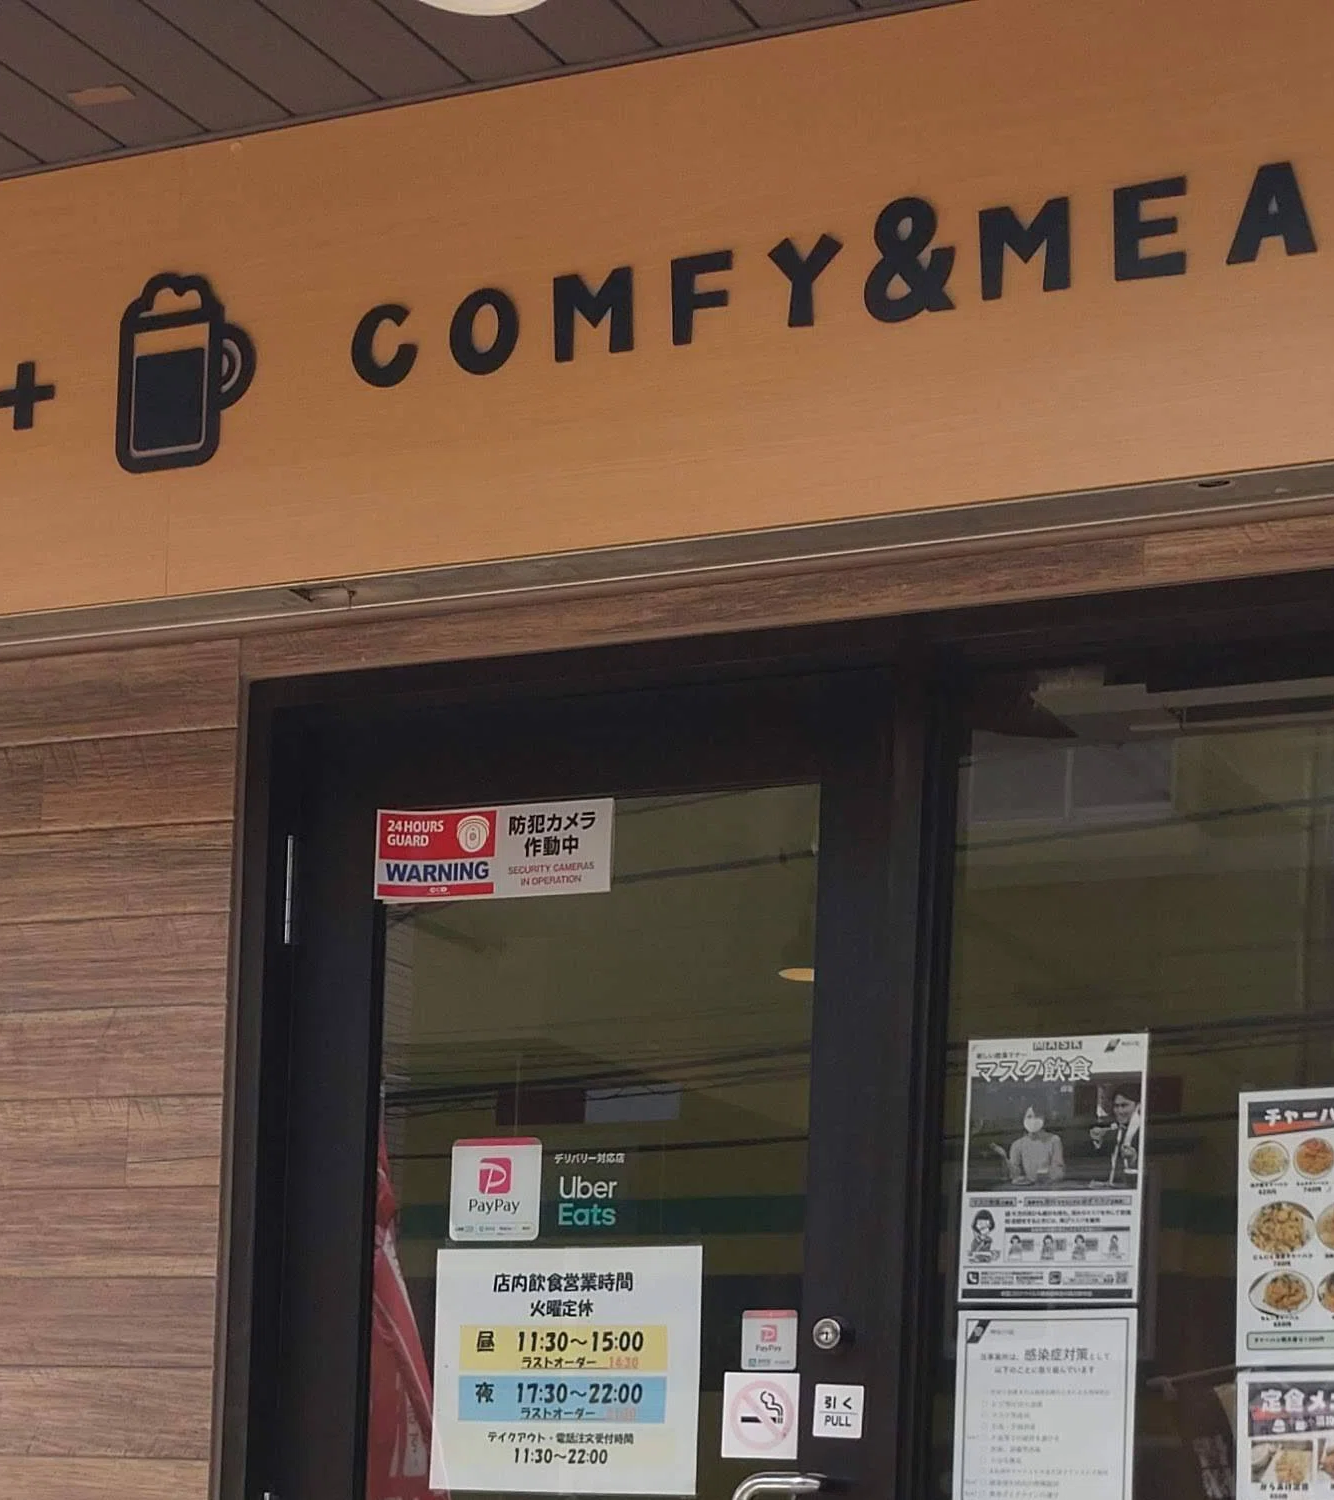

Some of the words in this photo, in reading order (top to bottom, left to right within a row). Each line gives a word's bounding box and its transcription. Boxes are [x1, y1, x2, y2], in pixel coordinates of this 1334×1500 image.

[508, 811, 596, 836] 防犯カメラ
[387, 834, 429, 847] GUARD
[524, 835, 579, 858] 作動中
[386, 861, 489, 883] WARNING
[508, 864, 551, 875] SECURITY
[554, 861, 595, 872] CAMERAS
[532, 875, 582, 886] OPERATION
[976, 1055, 1093, 1082] マスク飲食
[554, 1153, 625, 1164] デリバリー対応店
[559, 1176, 617, 1199] Uber
[469, 1199, 520, 1215] PayPay
[558, 1203, 616, 1225] Eats
[493, 1272, 634, 1293] 店内飲食営業時間
[530, 1300, 594, 1317] 火曜定休
[476, 1331, 494, 1352] 昼
[522, 1357, 597, 1369] ラストオーダー
[475, 1382, 494, 1404] 夜
[824, 1396, 852, 1410] 引く
[521, 1407, 595, 1420] ラストオーダー
[824, 1415, 852, 1427] PULL
[487, 1431, 634, 1444] テイクアウト・電話注文受付時間
